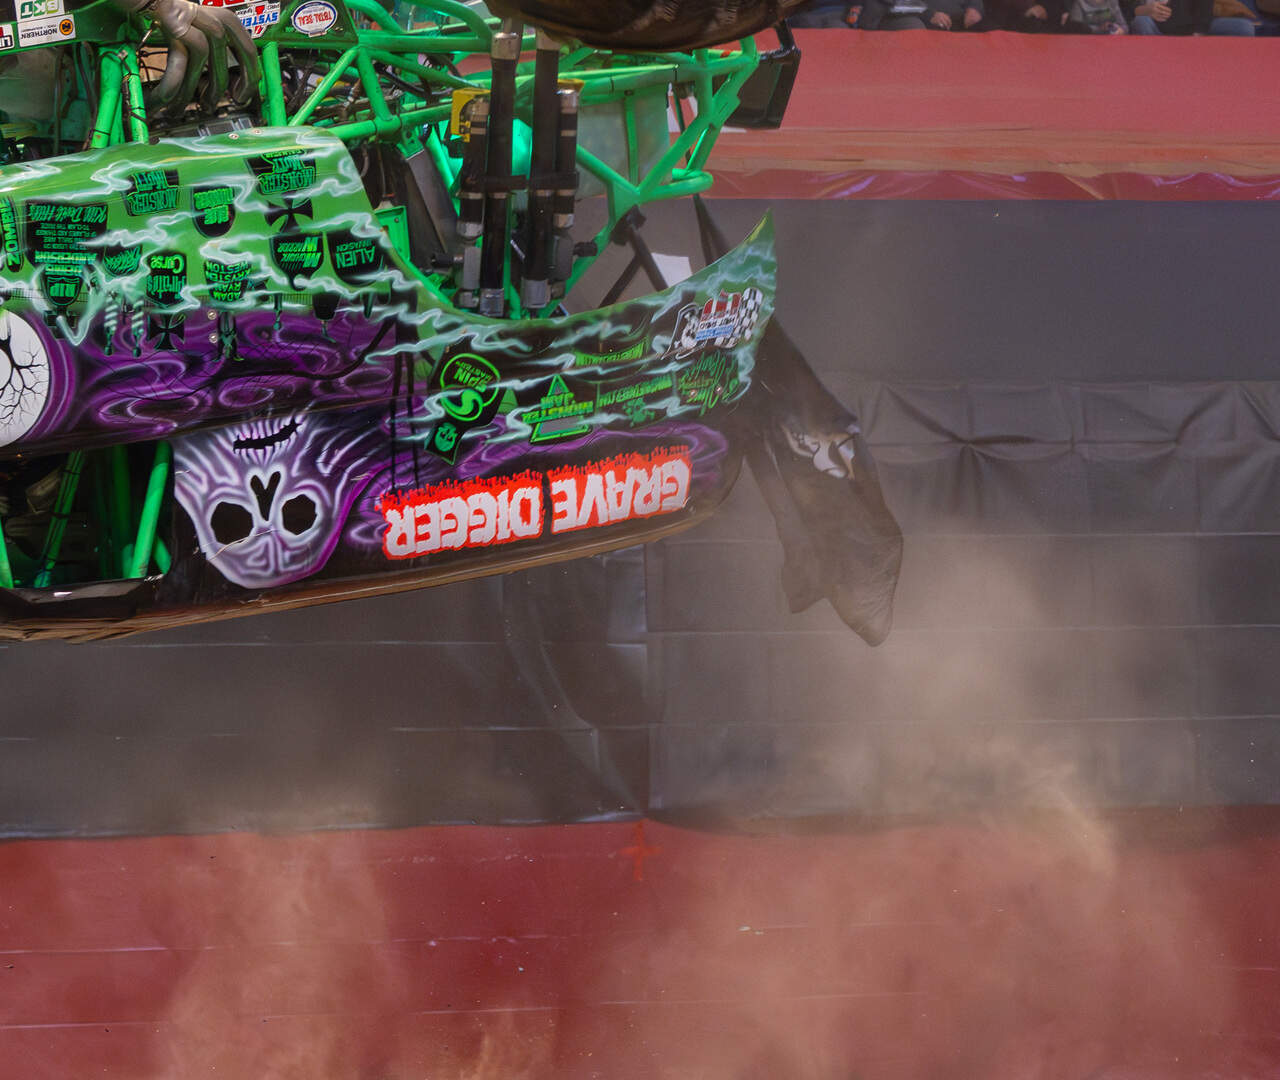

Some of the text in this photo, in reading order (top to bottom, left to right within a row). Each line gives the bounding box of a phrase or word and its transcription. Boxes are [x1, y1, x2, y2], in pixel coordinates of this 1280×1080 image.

[21, 28, 58, 40] NORTHERN
[257, 168, 315, 193] MONSTER
[127, 188, 178, 215] MONSTER
[29, 205, 56, 221] Hills
[84, 206, 107, 223] Kill
[150, 254, 184, 274] Curse
[336, 246, 376, 268] ALIEN
[213, 291, 240, 301] ADAM
[454, 368, 486, 392] SPIN
[385, 455, 692, 558] GRAVE DIGGER
